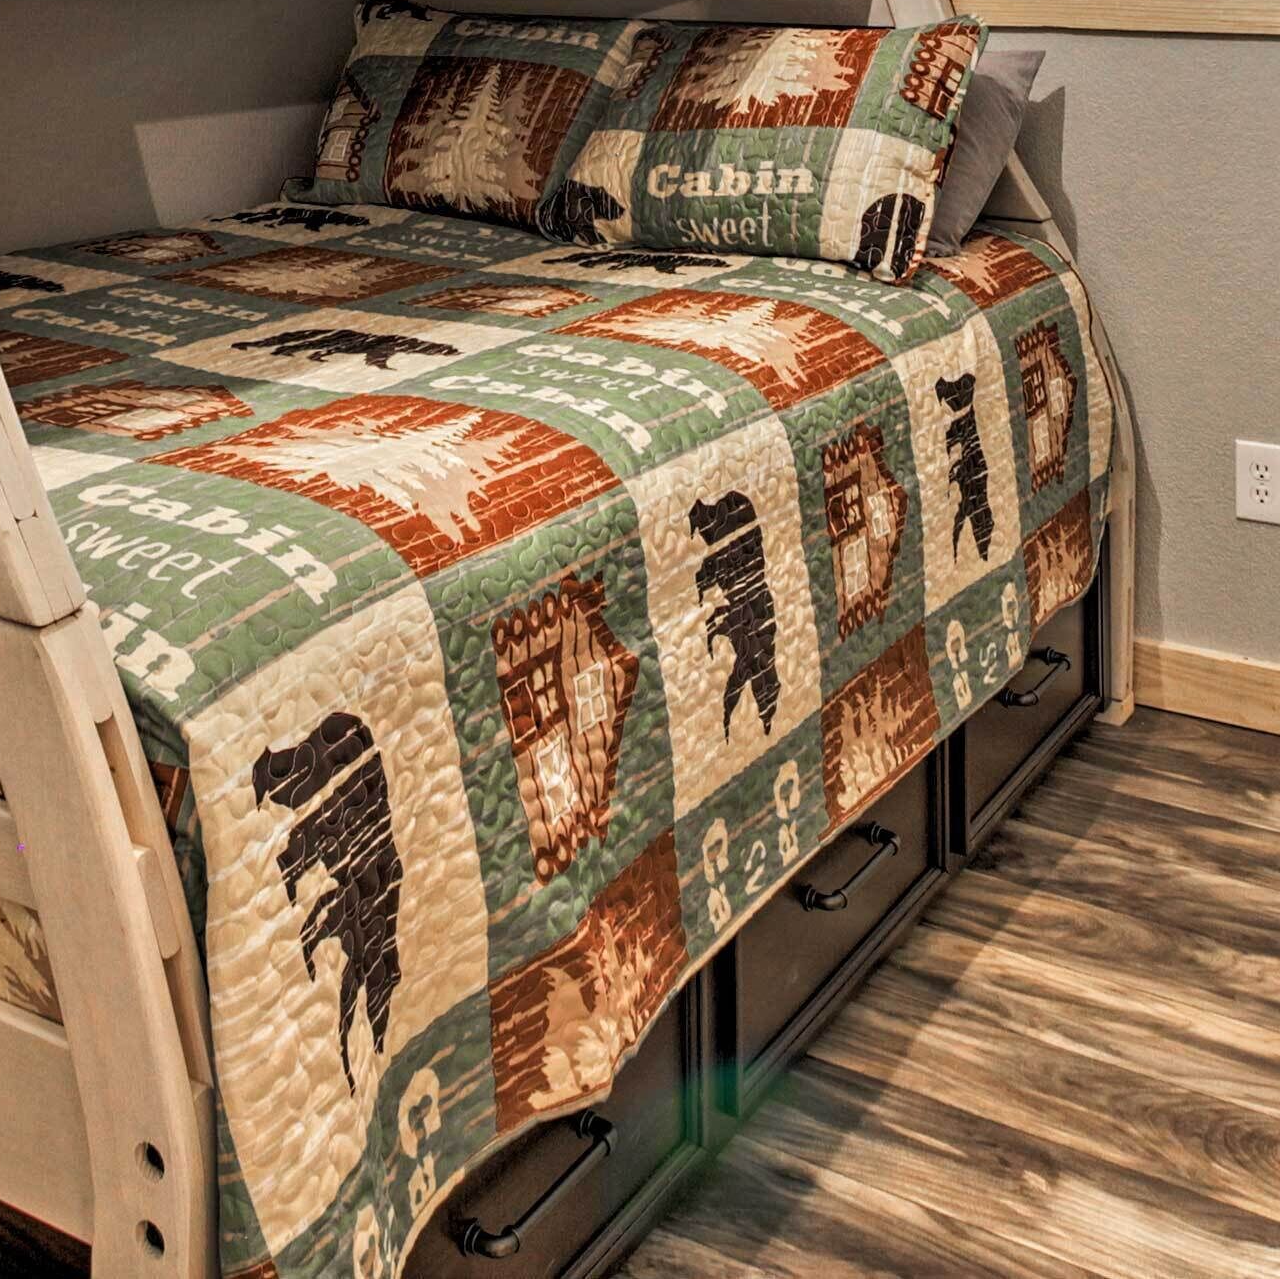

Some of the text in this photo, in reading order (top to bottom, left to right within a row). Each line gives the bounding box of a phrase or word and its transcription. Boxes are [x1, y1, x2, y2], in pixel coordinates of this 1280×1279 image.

[646, 160, 815, 199] Cabin
[676, 200, 774, 248] sweet
[12, 308, 178, 347] Cabin
[429, 373, 651, 453] Cabin
[516, 344, 729, 419] Cabin
[65, 521, 244, 600] sweet
[77, 483, 338, 605] Cabin
